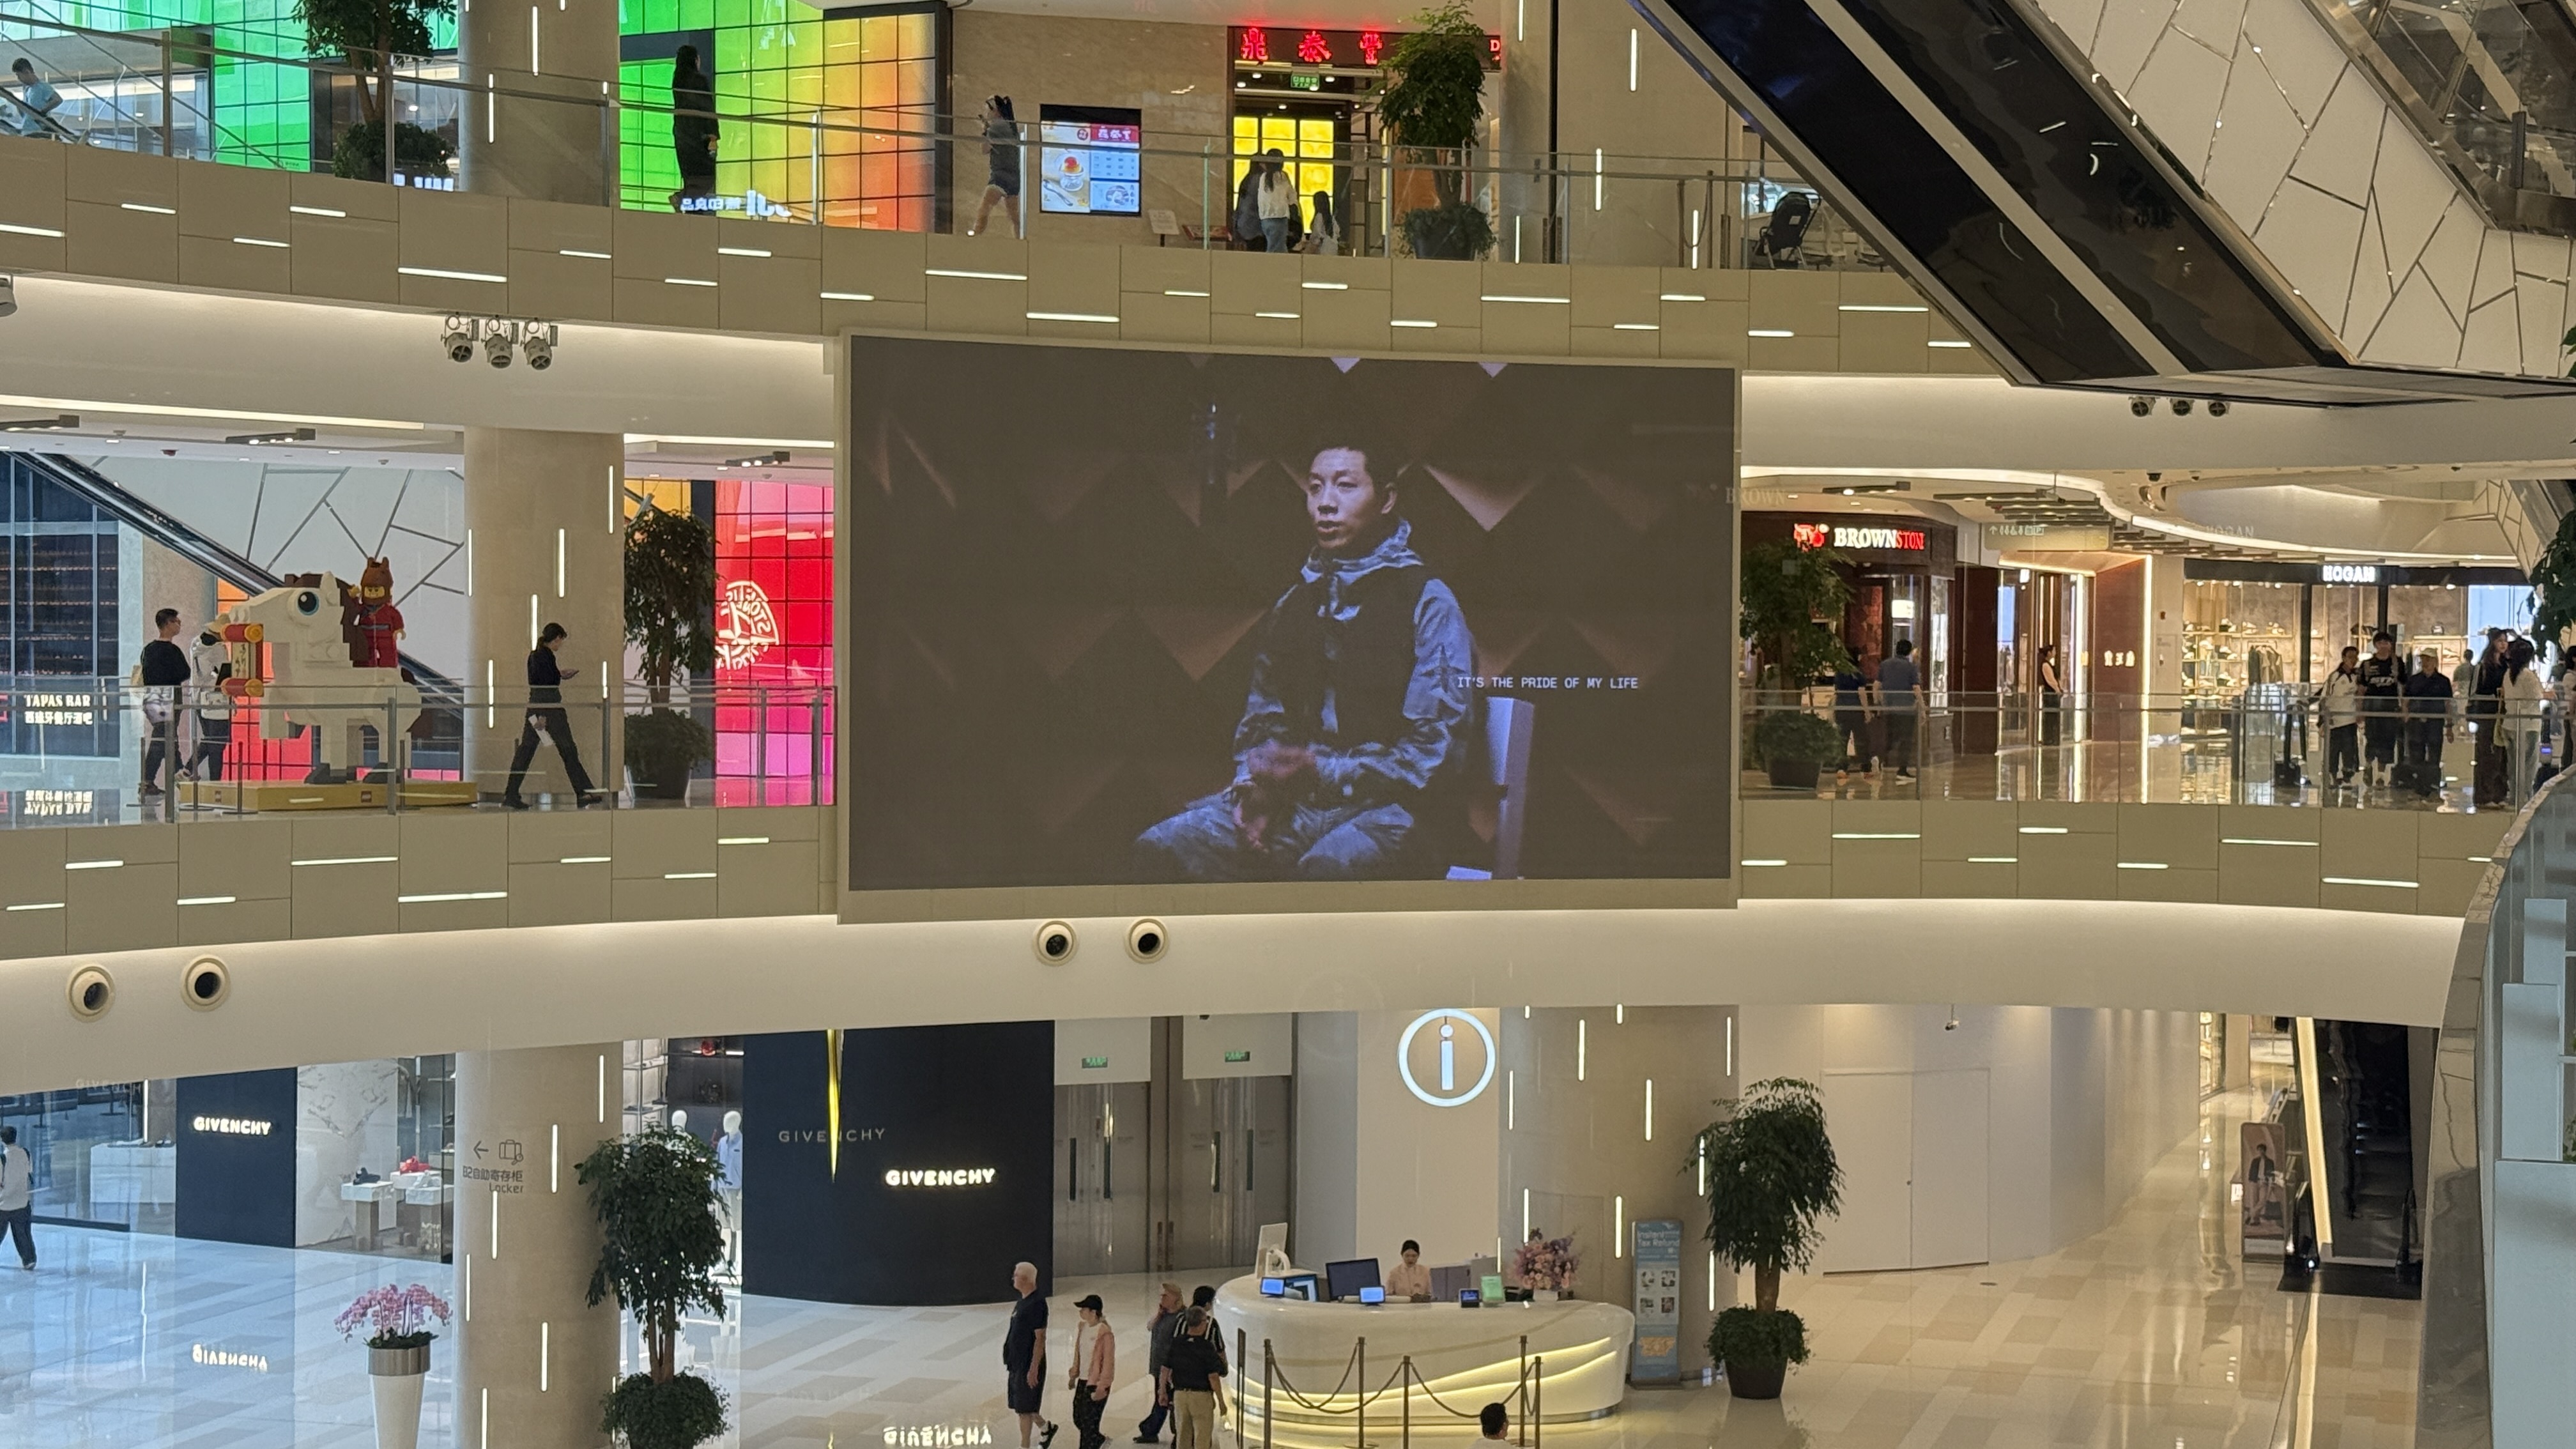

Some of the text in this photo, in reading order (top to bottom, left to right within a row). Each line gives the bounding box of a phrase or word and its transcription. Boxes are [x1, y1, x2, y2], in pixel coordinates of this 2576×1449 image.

[2323, 565, 2375, 582] HOGAN
[1457, 676, 1639, 689] IT'S THE PRIDE OF MY LIFE
[24, 694, 91, 707] TAPAS BAR
[194, 1116, 272, 1136] GIVENCHY
[885, 1168, 995, 1187] GIVENCHY
[489, 1182, 524, 1194] Locker
